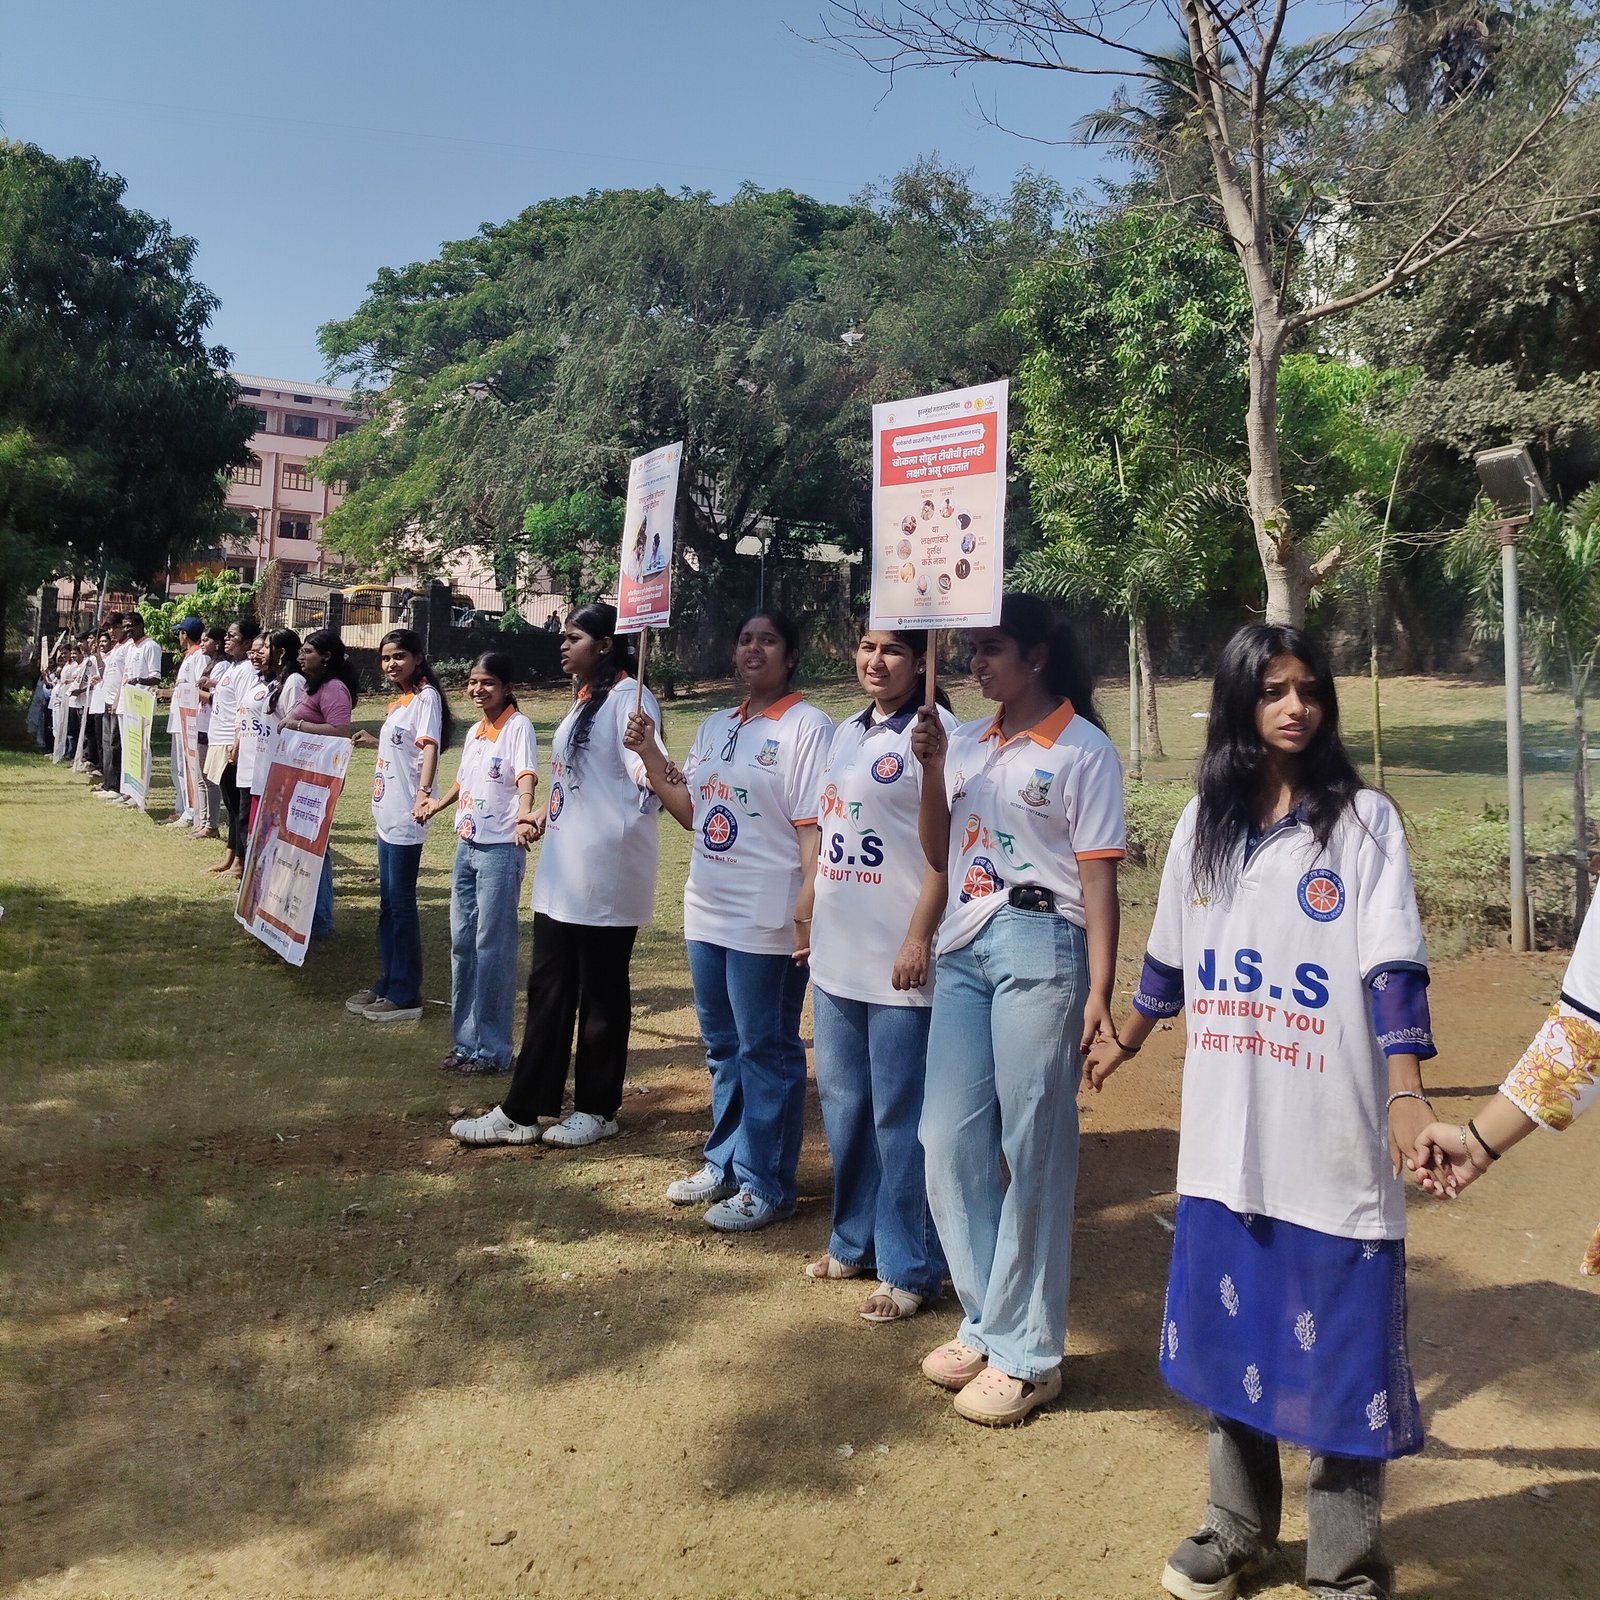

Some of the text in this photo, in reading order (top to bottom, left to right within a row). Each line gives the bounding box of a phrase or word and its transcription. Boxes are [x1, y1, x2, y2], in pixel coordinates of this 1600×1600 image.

[892, 455, 918, 467] खोकला
[938, 446, 961, 460] टीबीची
[962, 443, 985, 459] इतरही
[906, 462, 969, 478] लक्षणे असू शकतात
[920, 533, 949, 545] लक्षणांकडे
[927, 545, 942, 558] दुर्लक्ष
[933, 557, 946, 565] नका
[830, 868, 852, 881] BUT
[855, 870, 882, 884] YOU
[1238, 1000, 1276, 1022] BUT
[1283, 1010, 1325, 1035] YOU
[1202, 1026, 1229, 1052] सेवा
[1268, 1041, 1299, 1067] धर्म
